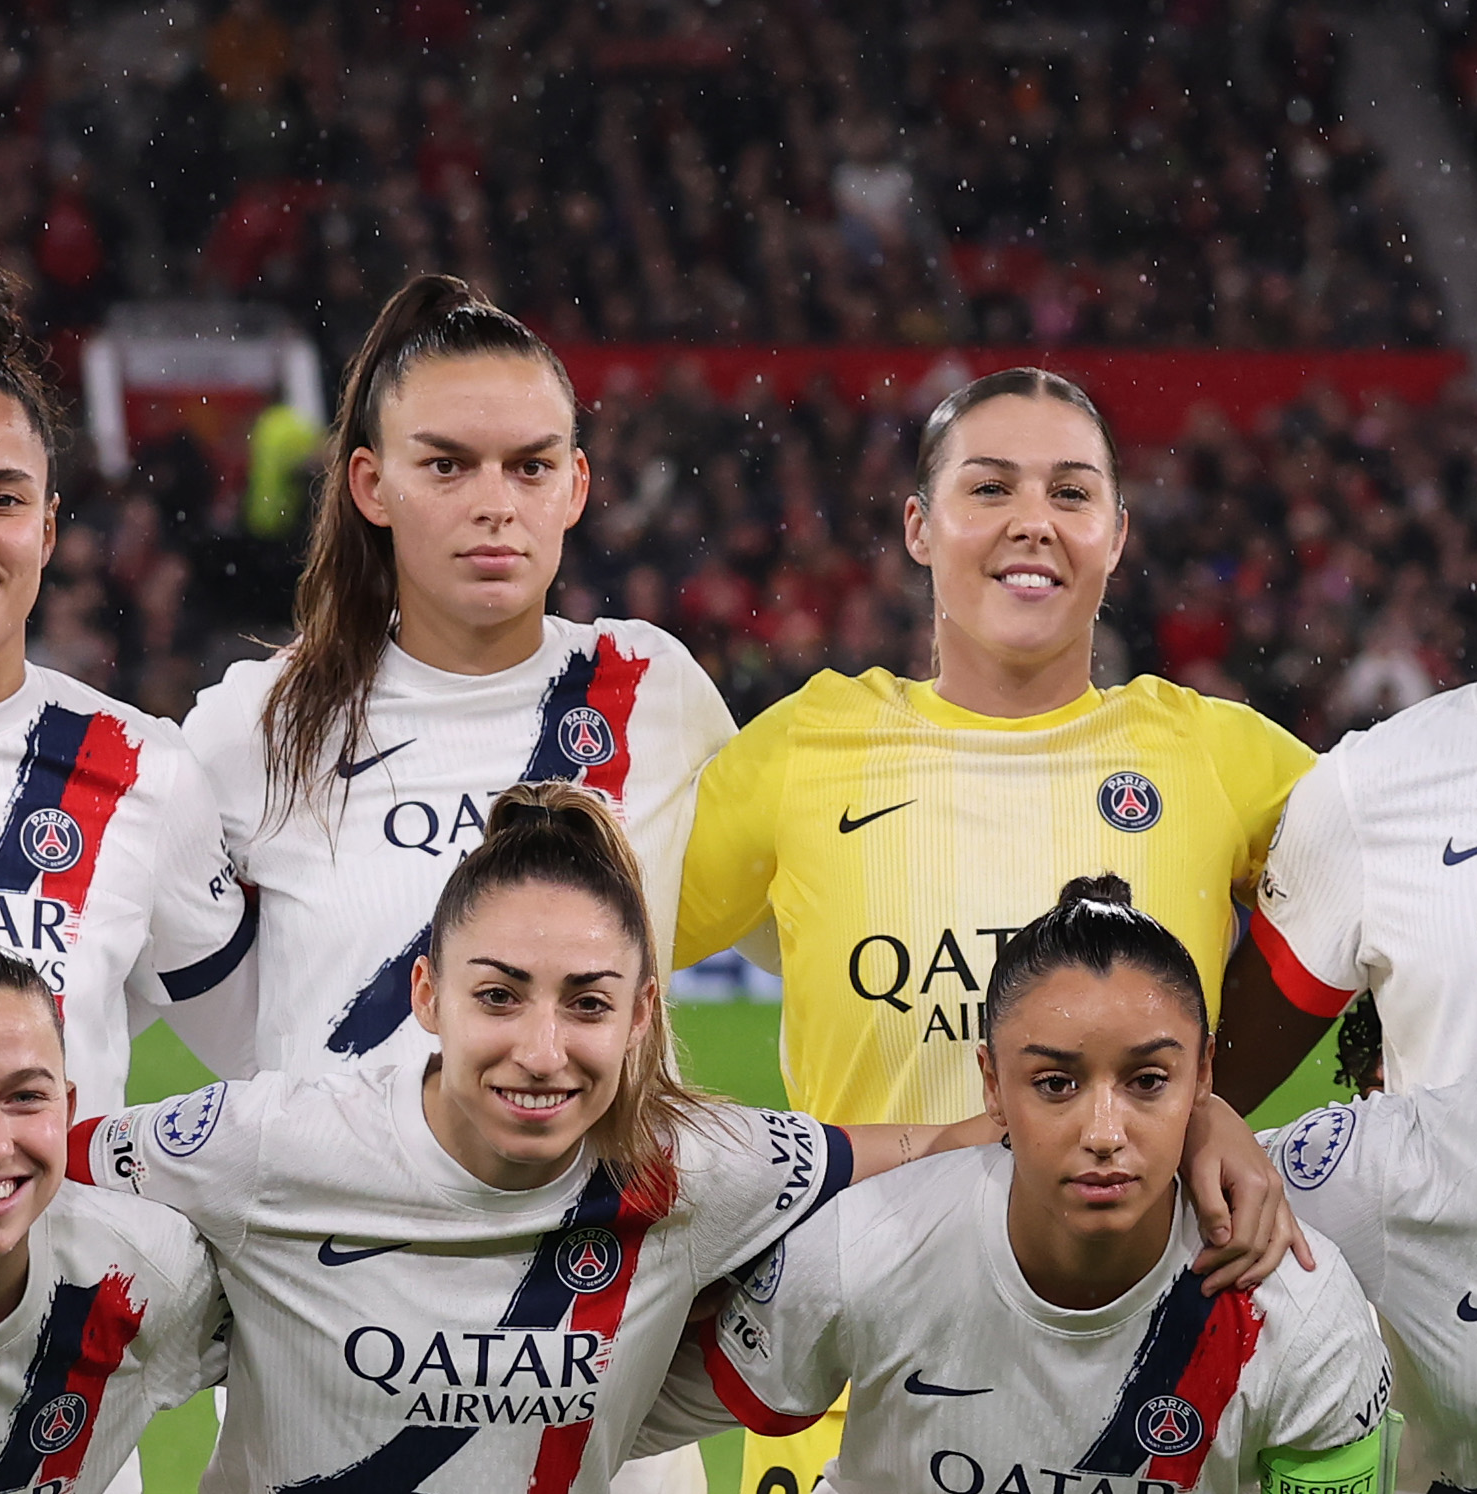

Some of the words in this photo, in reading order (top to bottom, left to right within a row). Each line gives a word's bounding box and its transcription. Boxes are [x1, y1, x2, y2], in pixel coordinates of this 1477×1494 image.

[565, 710, 601, 726] PARIS
[1107, 776, 1148, 790] PARIS
[30, 812, 72, 828] PARIS
[849, 928, 1025, 1013] QAT
[568, 1230, 610, 1246] PARIS
[734, 1316, 758, 1349] 10
[344, 1326, 599, 1396] QATAR
[1355, 1356, 1392, 1428] VISI
[41, 1396, 78, 1416] PARIS
[404, 1392, 596, 1424] AIRWAYS
[1148, 1399, 1192, 1416] PARIS
